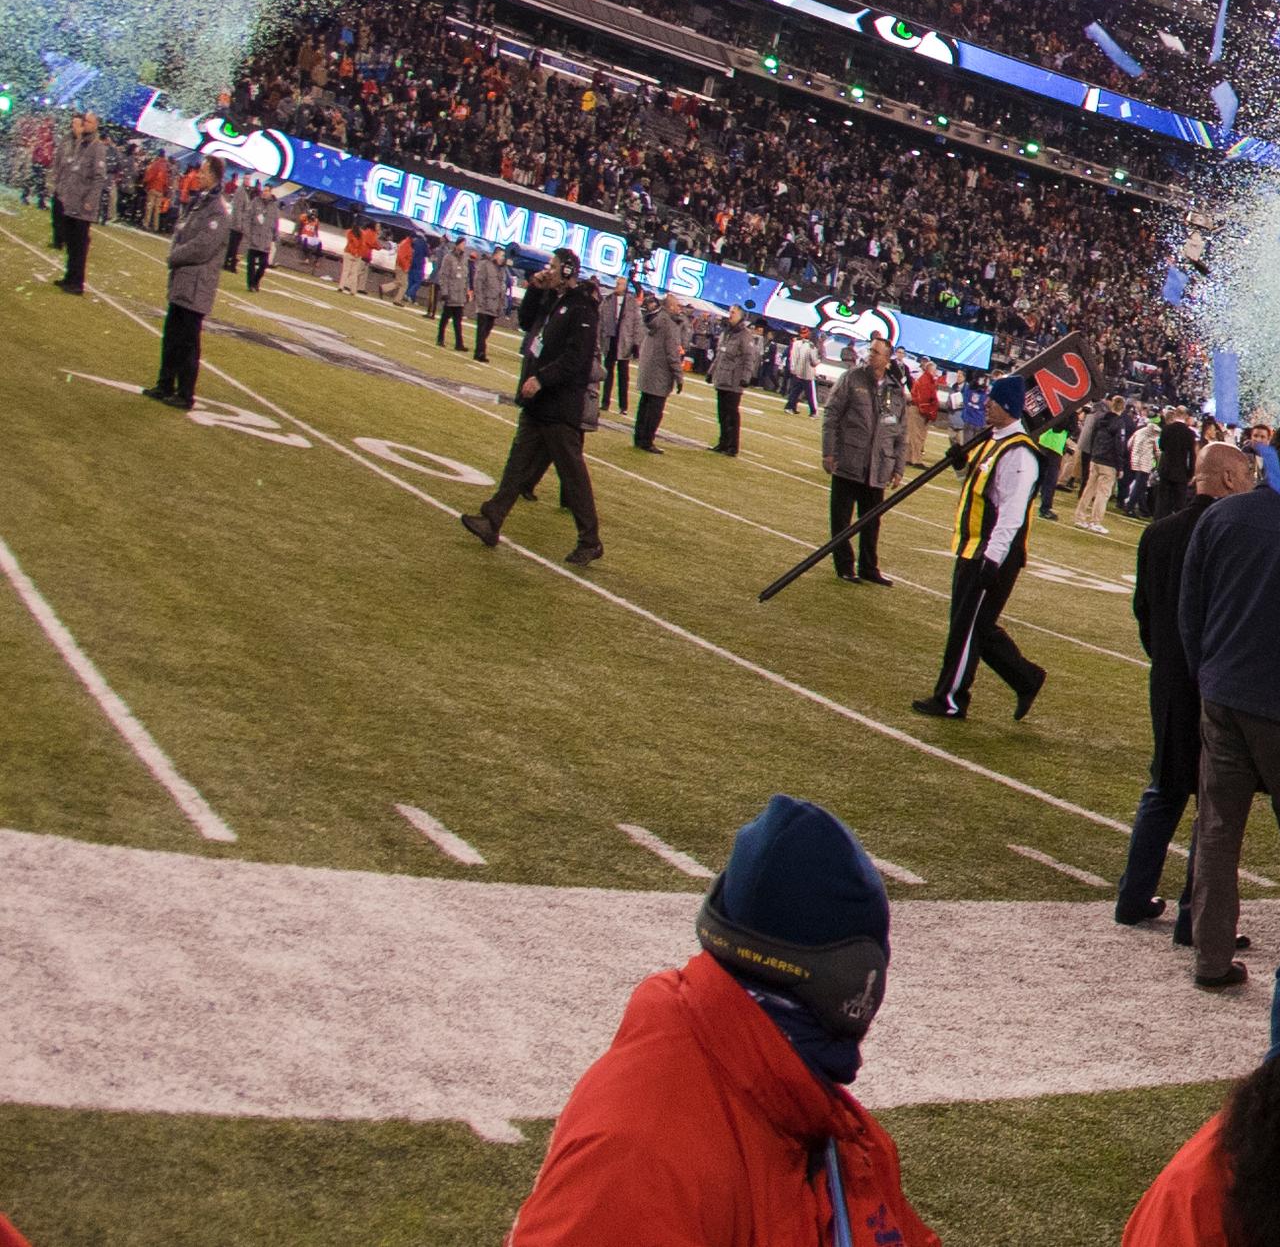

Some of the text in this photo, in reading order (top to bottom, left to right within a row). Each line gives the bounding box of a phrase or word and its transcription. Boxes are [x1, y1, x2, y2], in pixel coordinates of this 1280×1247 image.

[1034, 352, 1091, 417] 2
[736, 947, 811, 978] NEW JERSEY
